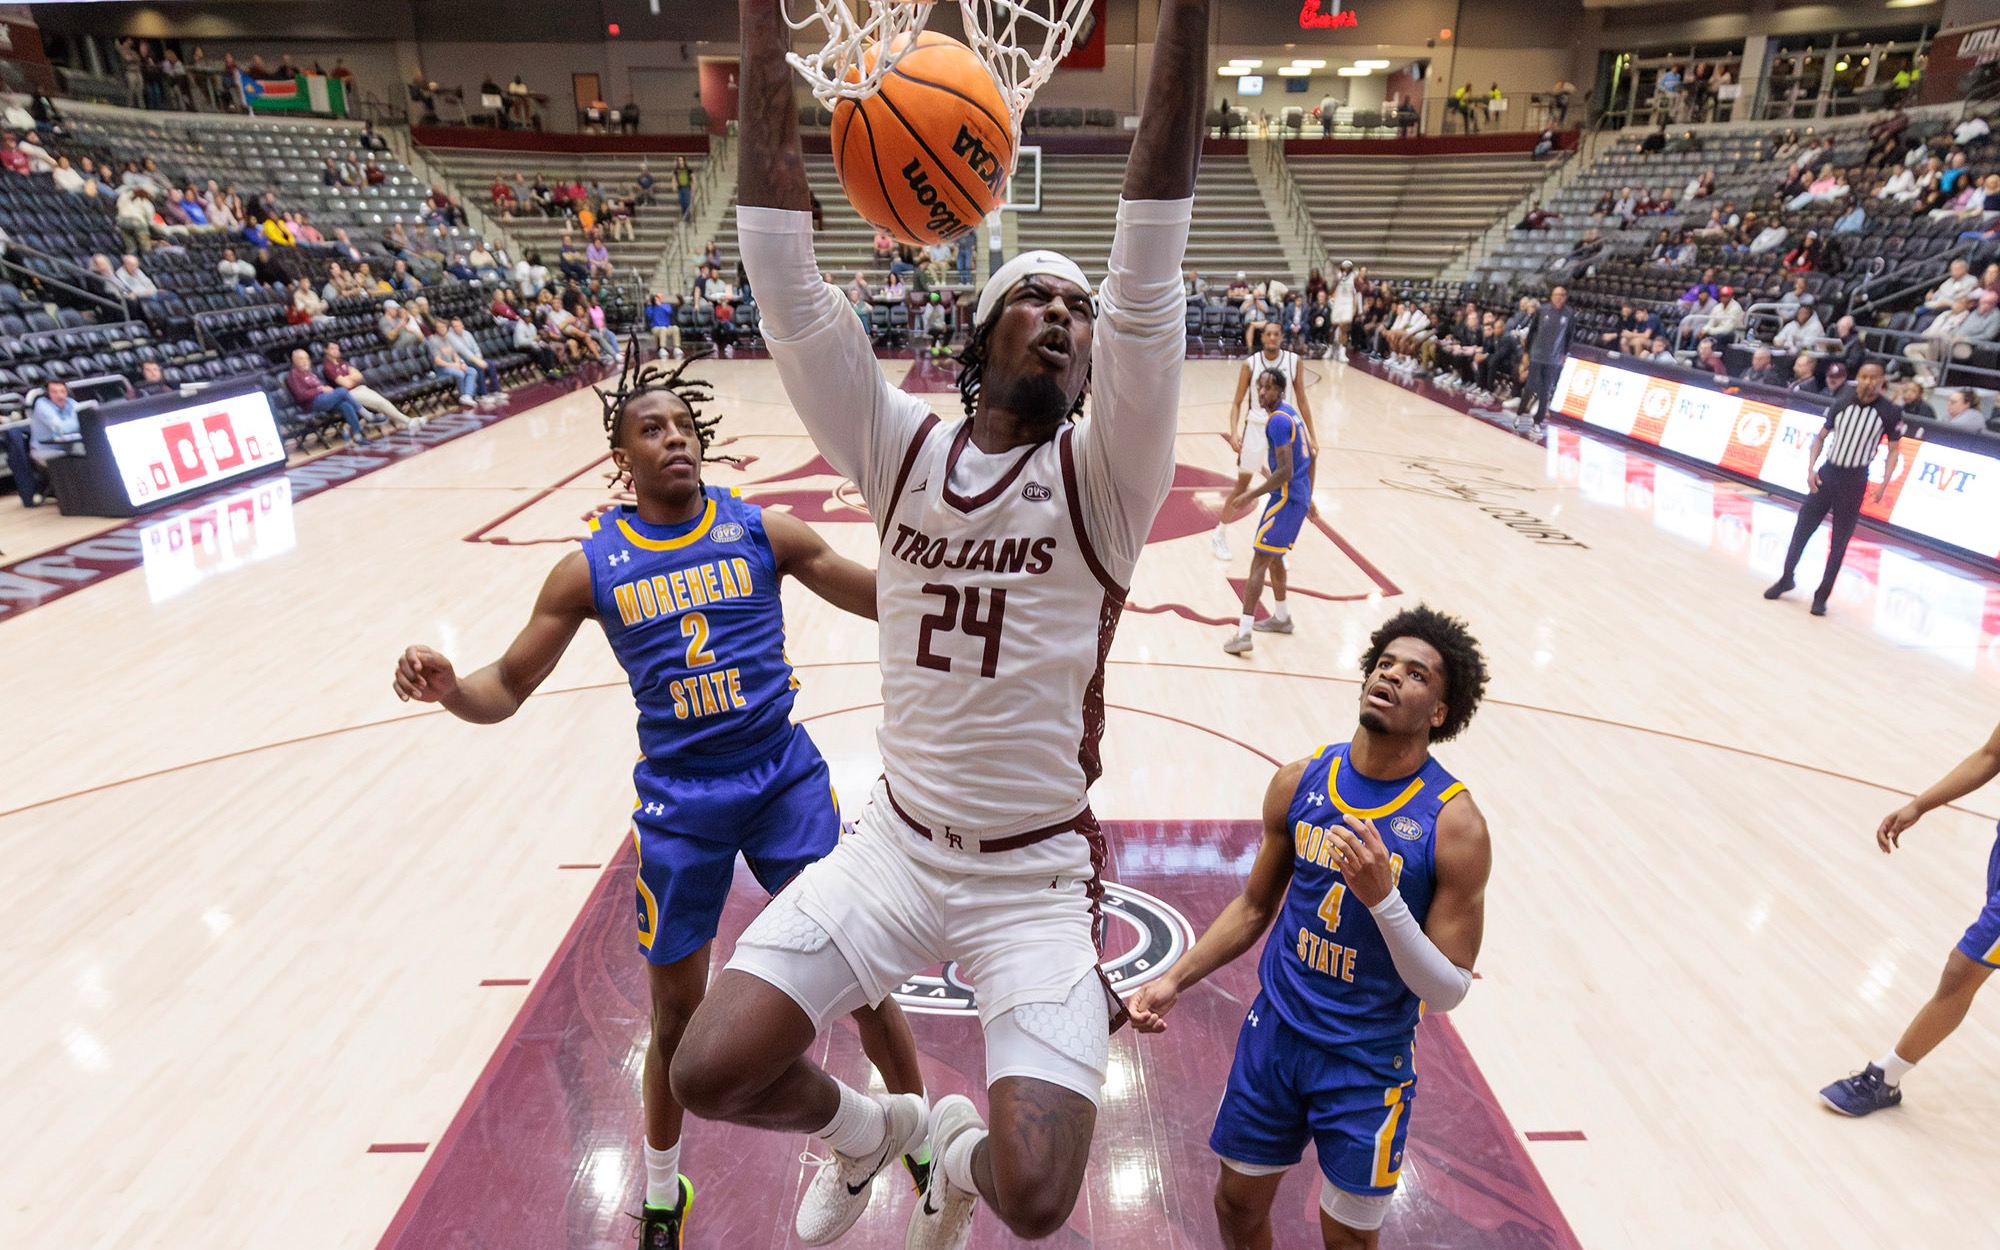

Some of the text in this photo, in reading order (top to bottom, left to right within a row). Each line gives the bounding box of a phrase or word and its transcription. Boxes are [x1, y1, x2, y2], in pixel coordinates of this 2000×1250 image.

[1918, 461, 1977, 493] RVT
[891, 523, 1057, 575] TROJANS
[613, 556, 753, 627] MOREHEAD
[680, 611, 716, 669] 2
[916, 582, 1008, 679] 24
[669, 667, 747, 720] STATE
[1317, 881, 1347, 933] 4
[1296, 926, 1358, 984] STATE
